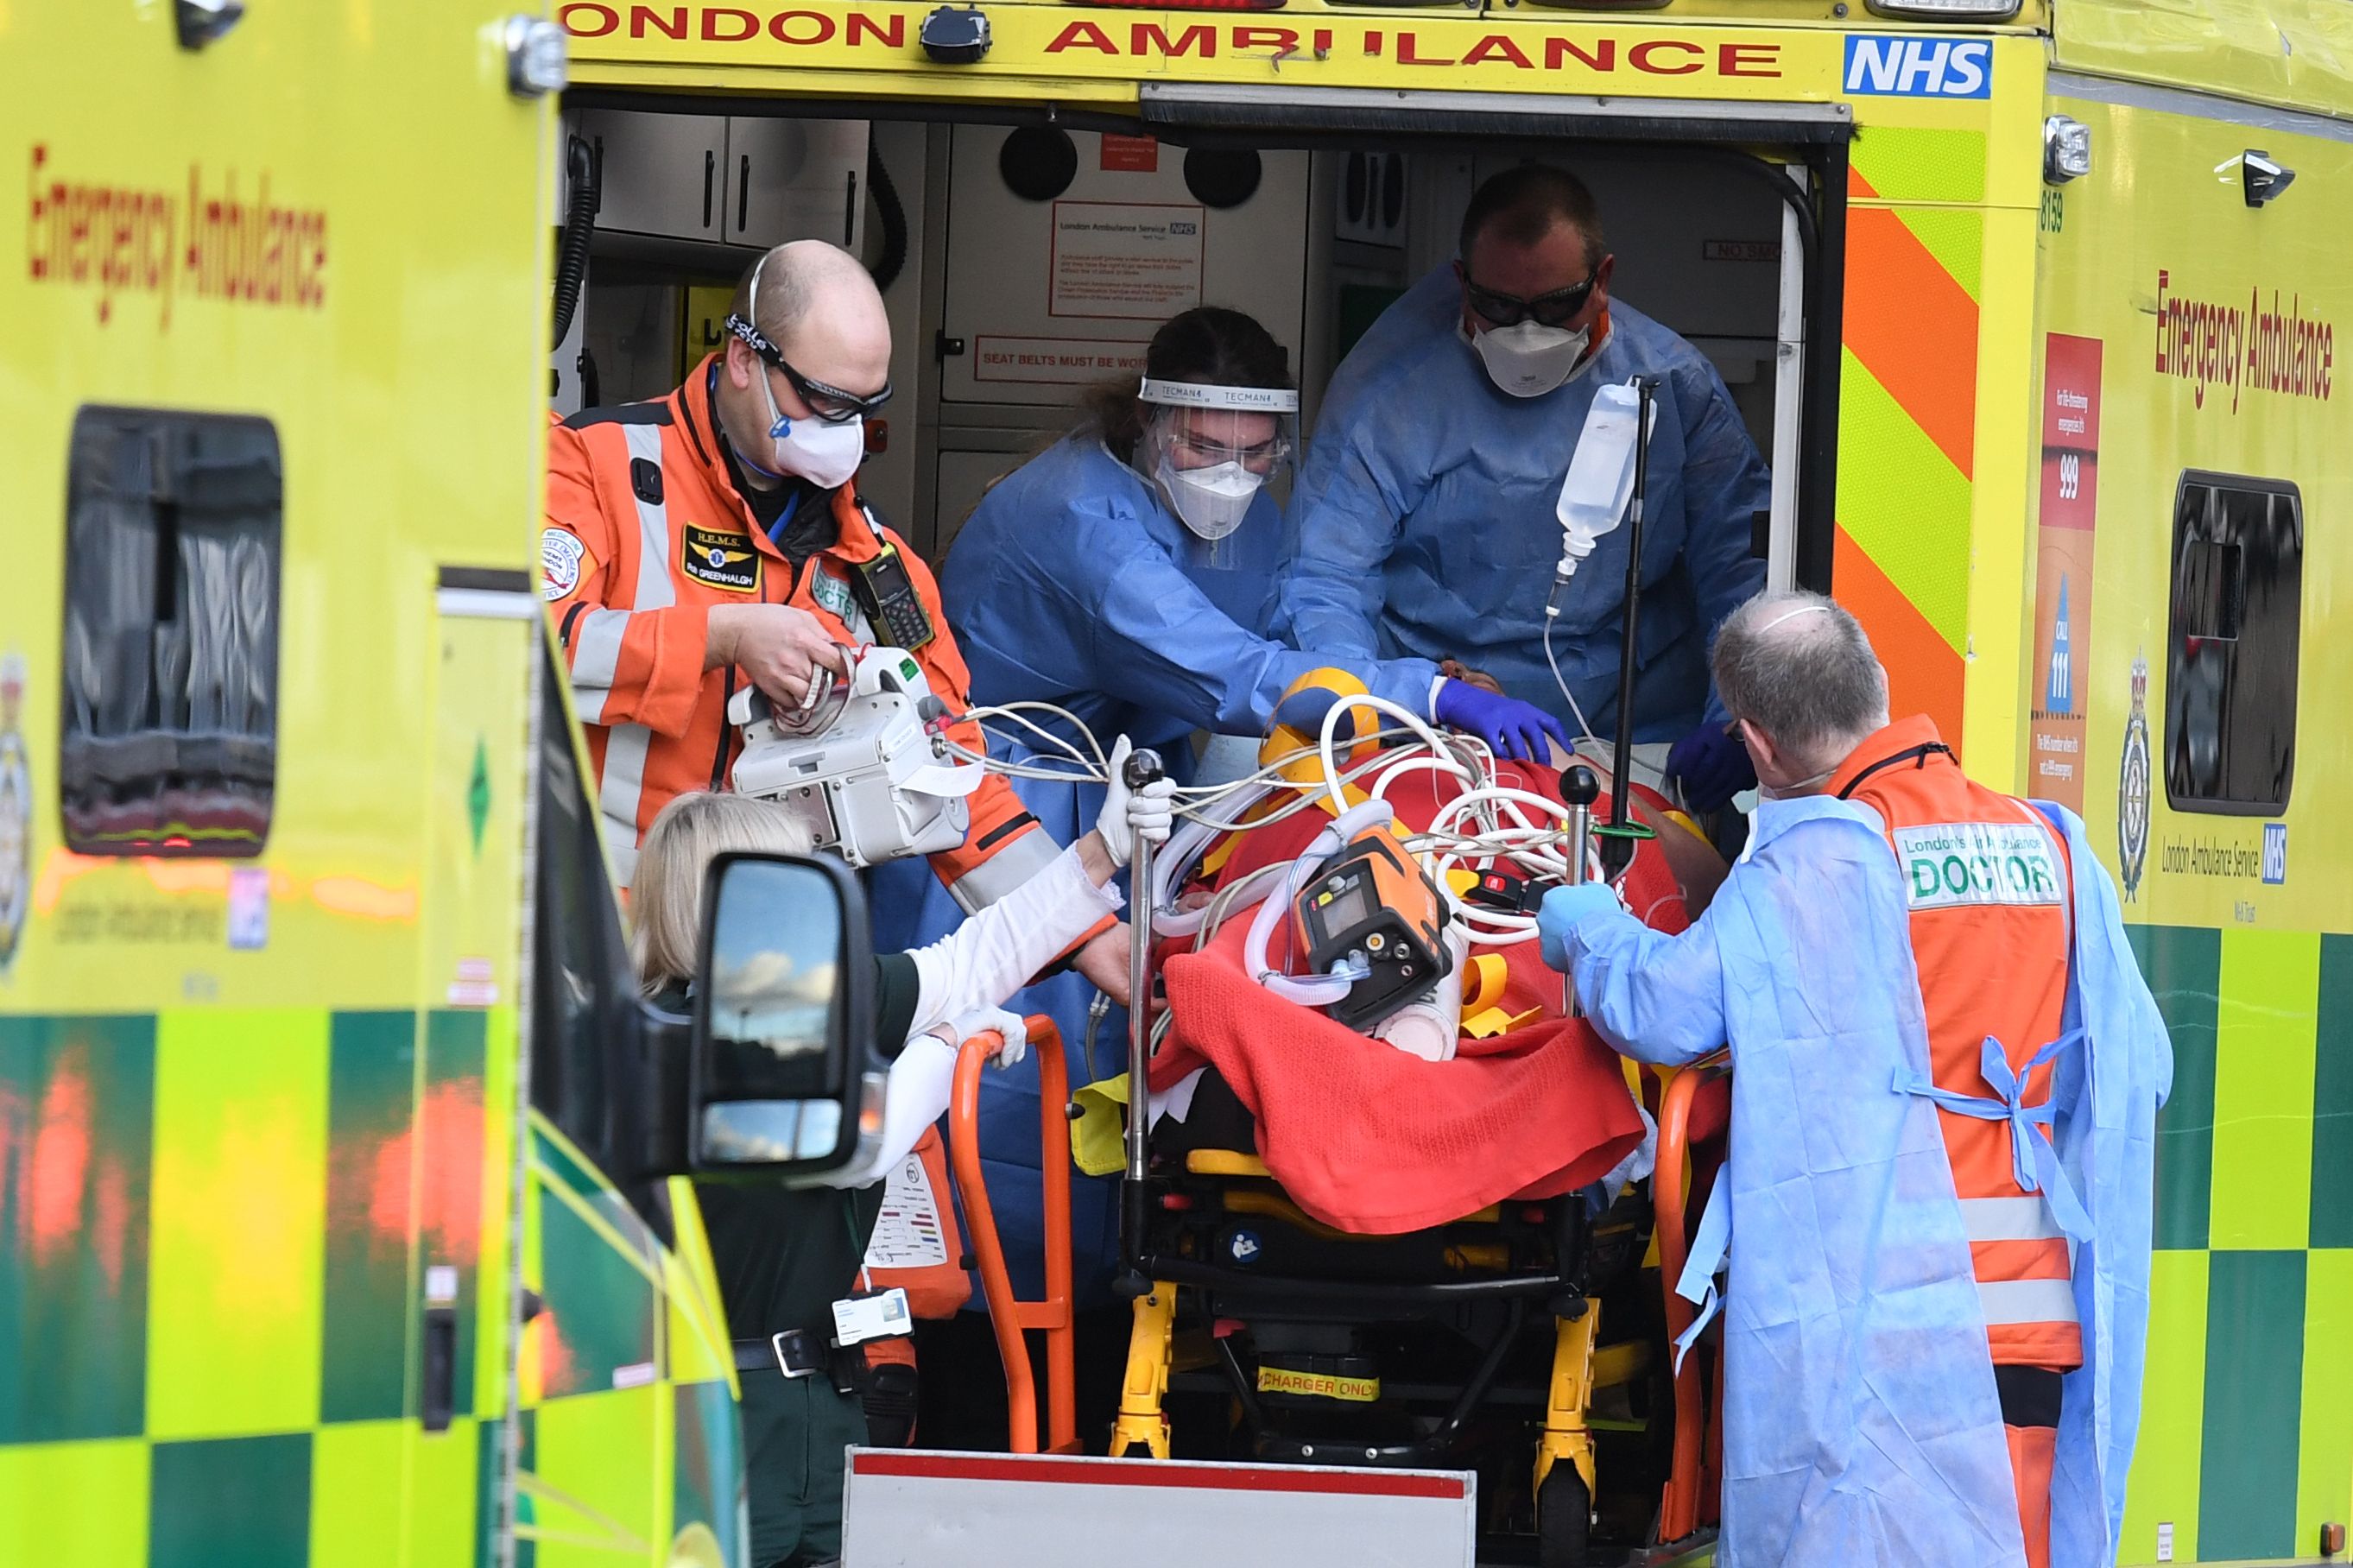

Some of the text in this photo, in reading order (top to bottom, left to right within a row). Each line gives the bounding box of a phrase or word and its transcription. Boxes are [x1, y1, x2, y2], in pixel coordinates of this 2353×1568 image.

[558, 3, 904, 47] ONDON
[1845, 39, 1987, 95] NHS
[2040, 189, 2063, 233] 8159
[1060, 223, 1196, 235] London Ambulance Service NHS
[1718, 243, 1741, 256] NO
[2155, 269, 2333, 415] Emergency Ambulance
[984, 353, 1148, 369] SEAT BELTS MUST BE WOR
[2059, 455, 2079, 501] 999
[698, 532, 741, 547] H.E.M.S.
[699, 569, 753, 585] GREENHALGH
[2056, 621, 2068, 641] CALL
[2052, 652, 2068, 699] 111
[1904, 836, 1966, 854] London's
[1987, 834, 2041, 851] Abulance
[2162, 827, 2286, 880] London Ambulance Service NHS
[1263, 1373, 1335, 1394] CHARGER
